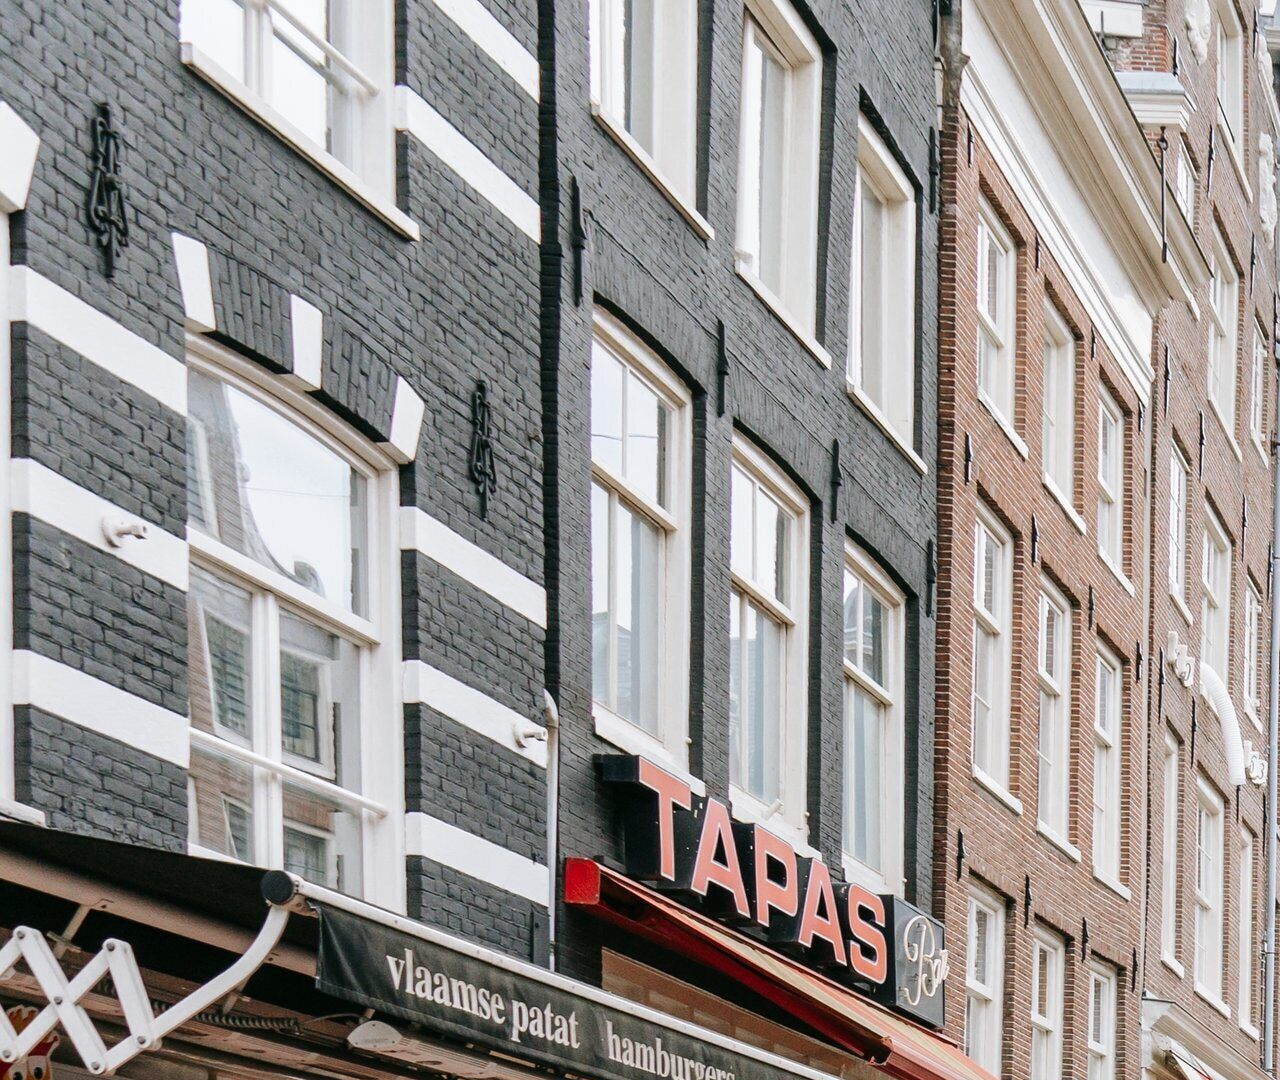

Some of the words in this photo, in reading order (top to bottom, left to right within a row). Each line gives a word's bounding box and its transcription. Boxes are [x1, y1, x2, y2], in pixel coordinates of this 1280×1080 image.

[639, 755, 888, 985] TAPAS
[903, 915, 949, 1006] Bar
[385, 948, 505, 1024] vlaamse
[510, 1000, 581, 1049] patat
